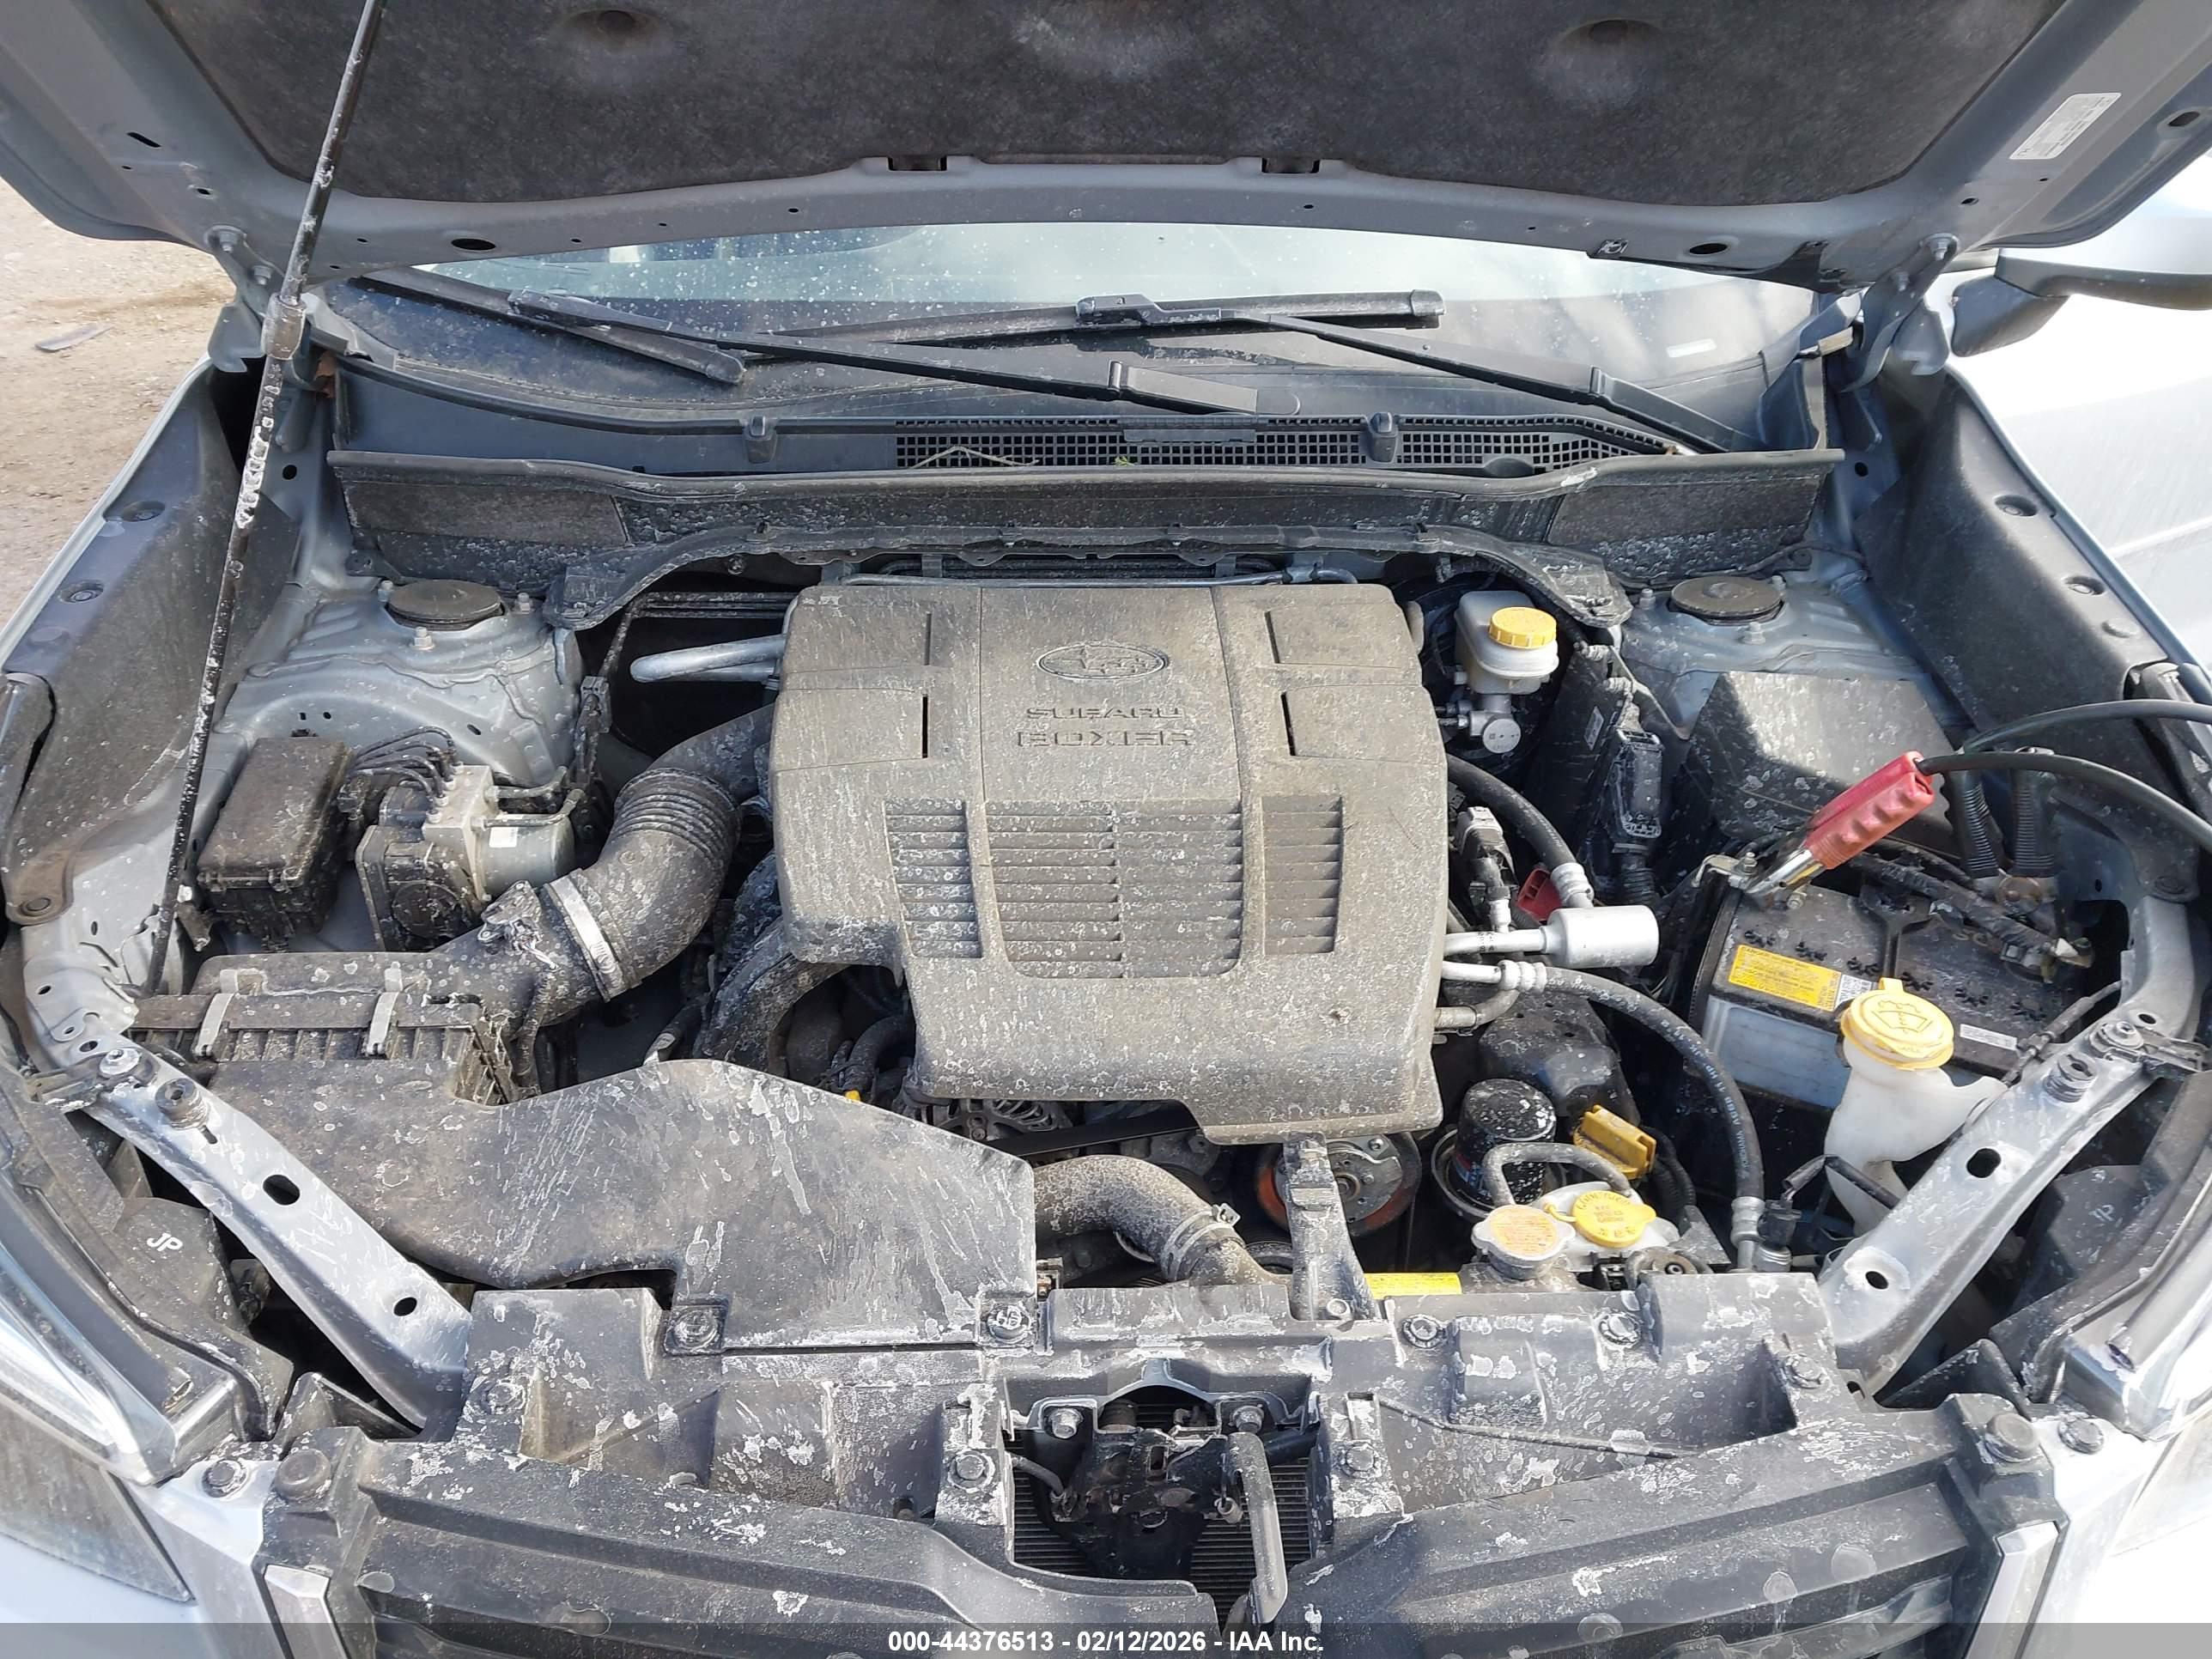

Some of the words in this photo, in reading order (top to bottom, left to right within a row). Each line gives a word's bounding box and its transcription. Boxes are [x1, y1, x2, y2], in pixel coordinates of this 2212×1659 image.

[1026, 707, 1183, 720] SUBARU
[1017, 731, 1196, 747] BOXER
[146, 1232, 184, 1252] JP
